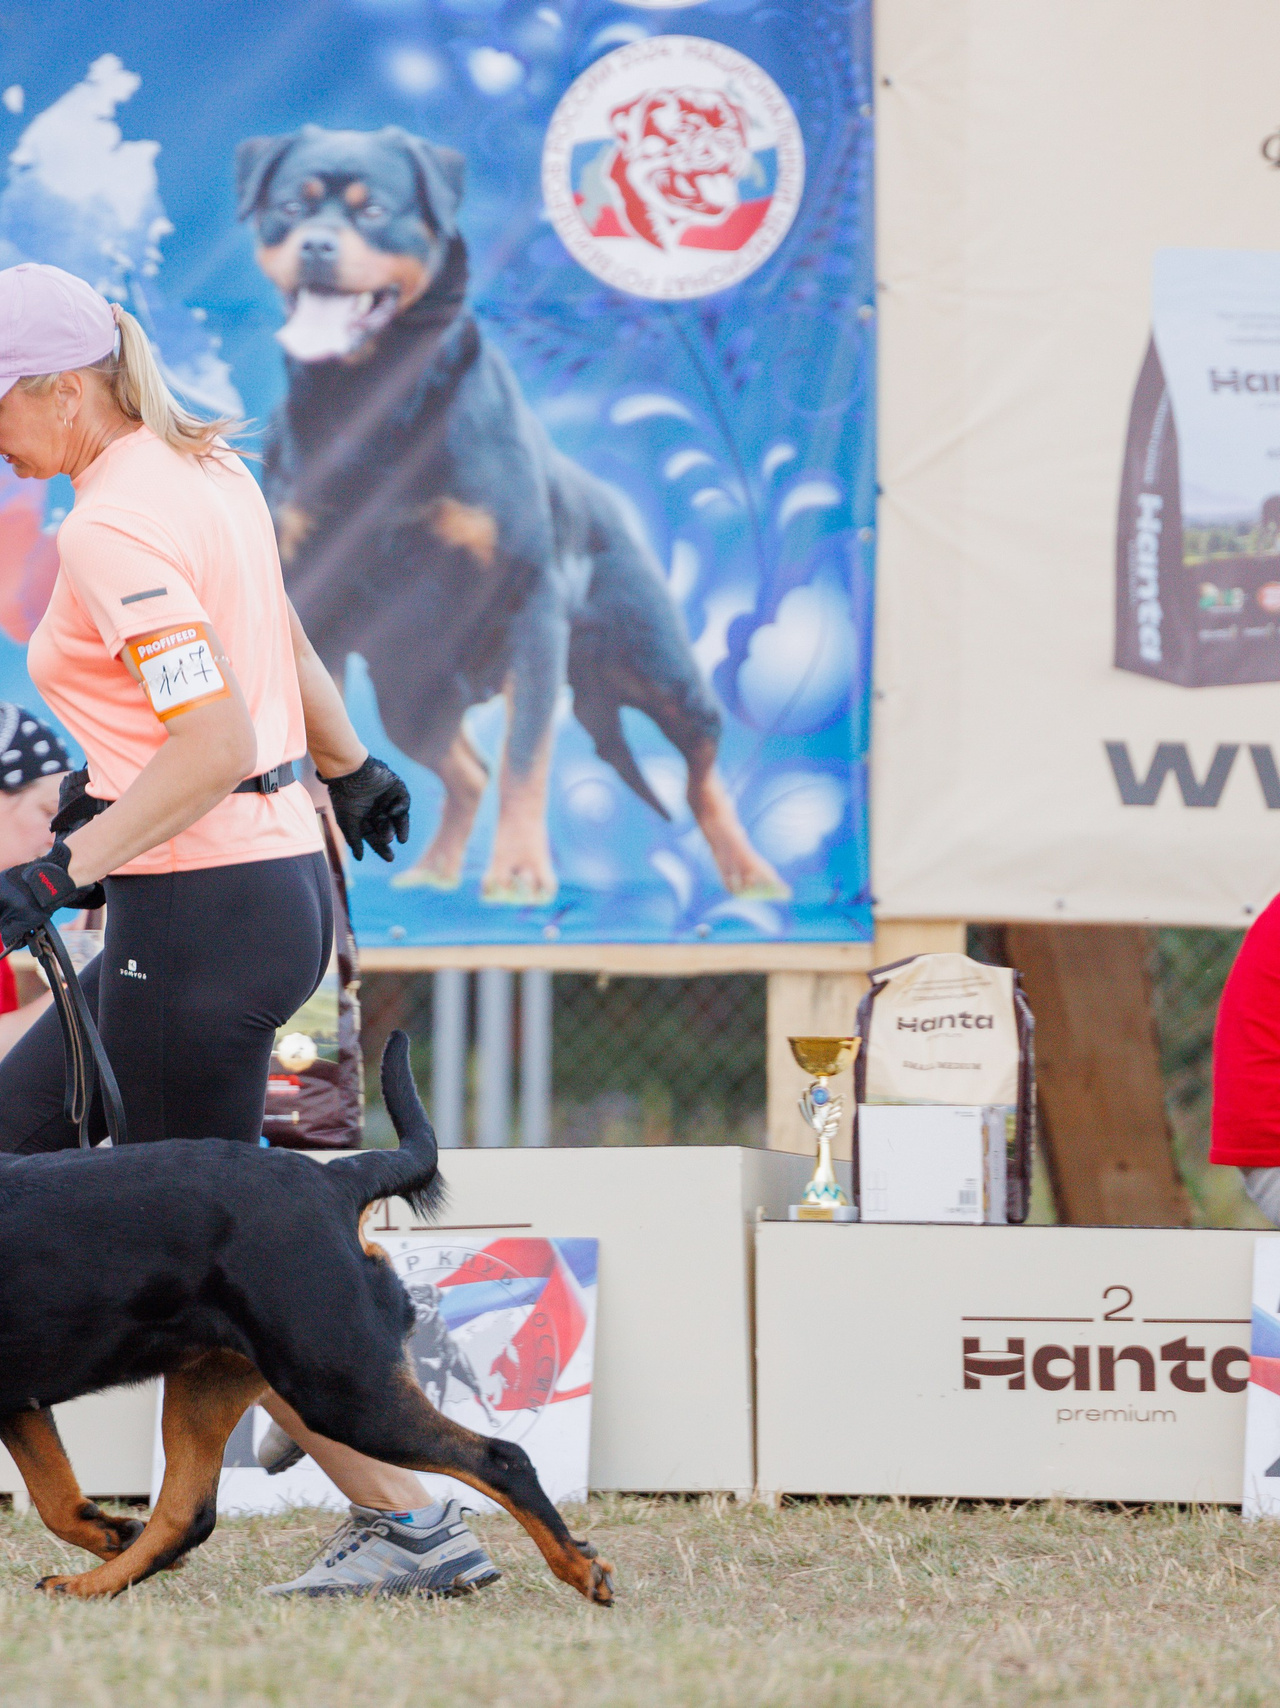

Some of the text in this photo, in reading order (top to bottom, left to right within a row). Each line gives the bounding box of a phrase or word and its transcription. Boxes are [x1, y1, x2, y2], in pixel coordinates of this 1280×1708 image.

[159, 644, 213, 696] 117
[896, 1011, 995, 1033] Hanta
[1102, 1284, 1135, 1322] 2
[1056, 1404, 1177, 1424] premium
